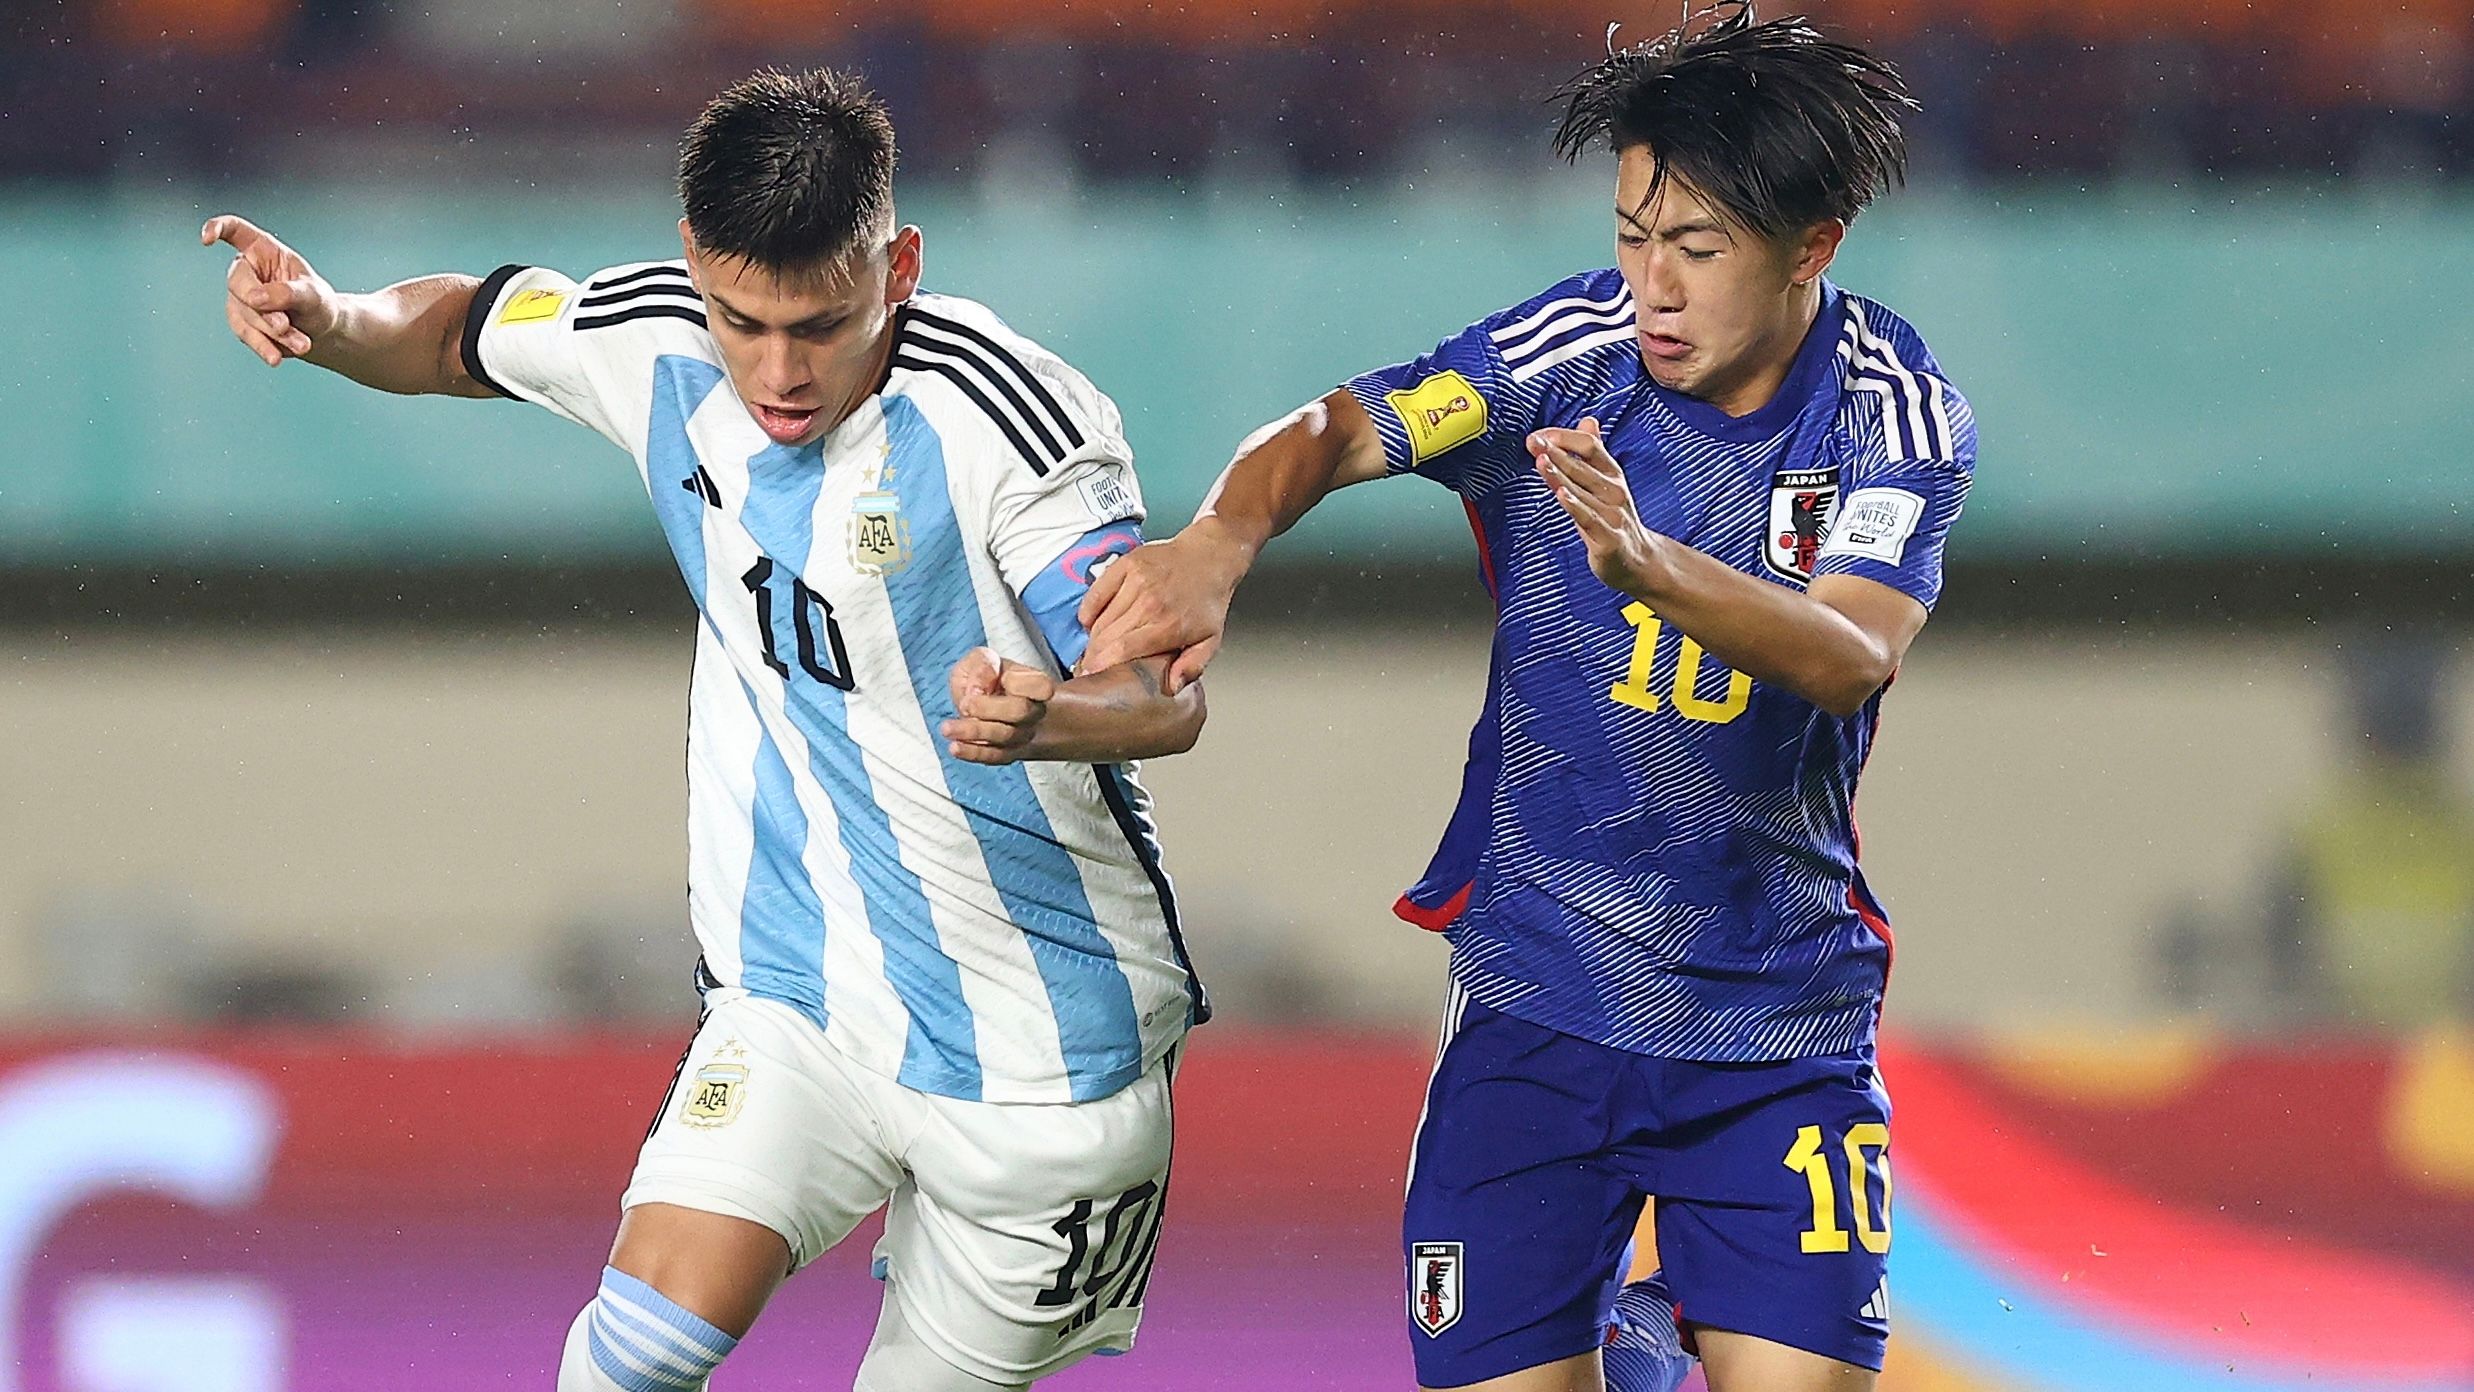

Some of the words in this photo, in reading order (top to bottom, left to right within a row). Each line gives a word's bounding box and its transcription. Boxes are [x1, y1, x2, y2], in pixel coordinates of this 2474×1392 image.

[1783, 474, 1828, 486] JAPAN
[858, 514, 895, 555] AFA
[1851, 534, 1874, 543] FIFA
[741, 556, 856, 692] 10
[1609, 600, 1753, 724] 10
[695, 1081, 729, 1111] AFA
[1783, 1123, 1893, 1253] 10
[1034, 1179, 1159, 1306] 10
[1422, 1246, 1447, 1255] JAPAN
